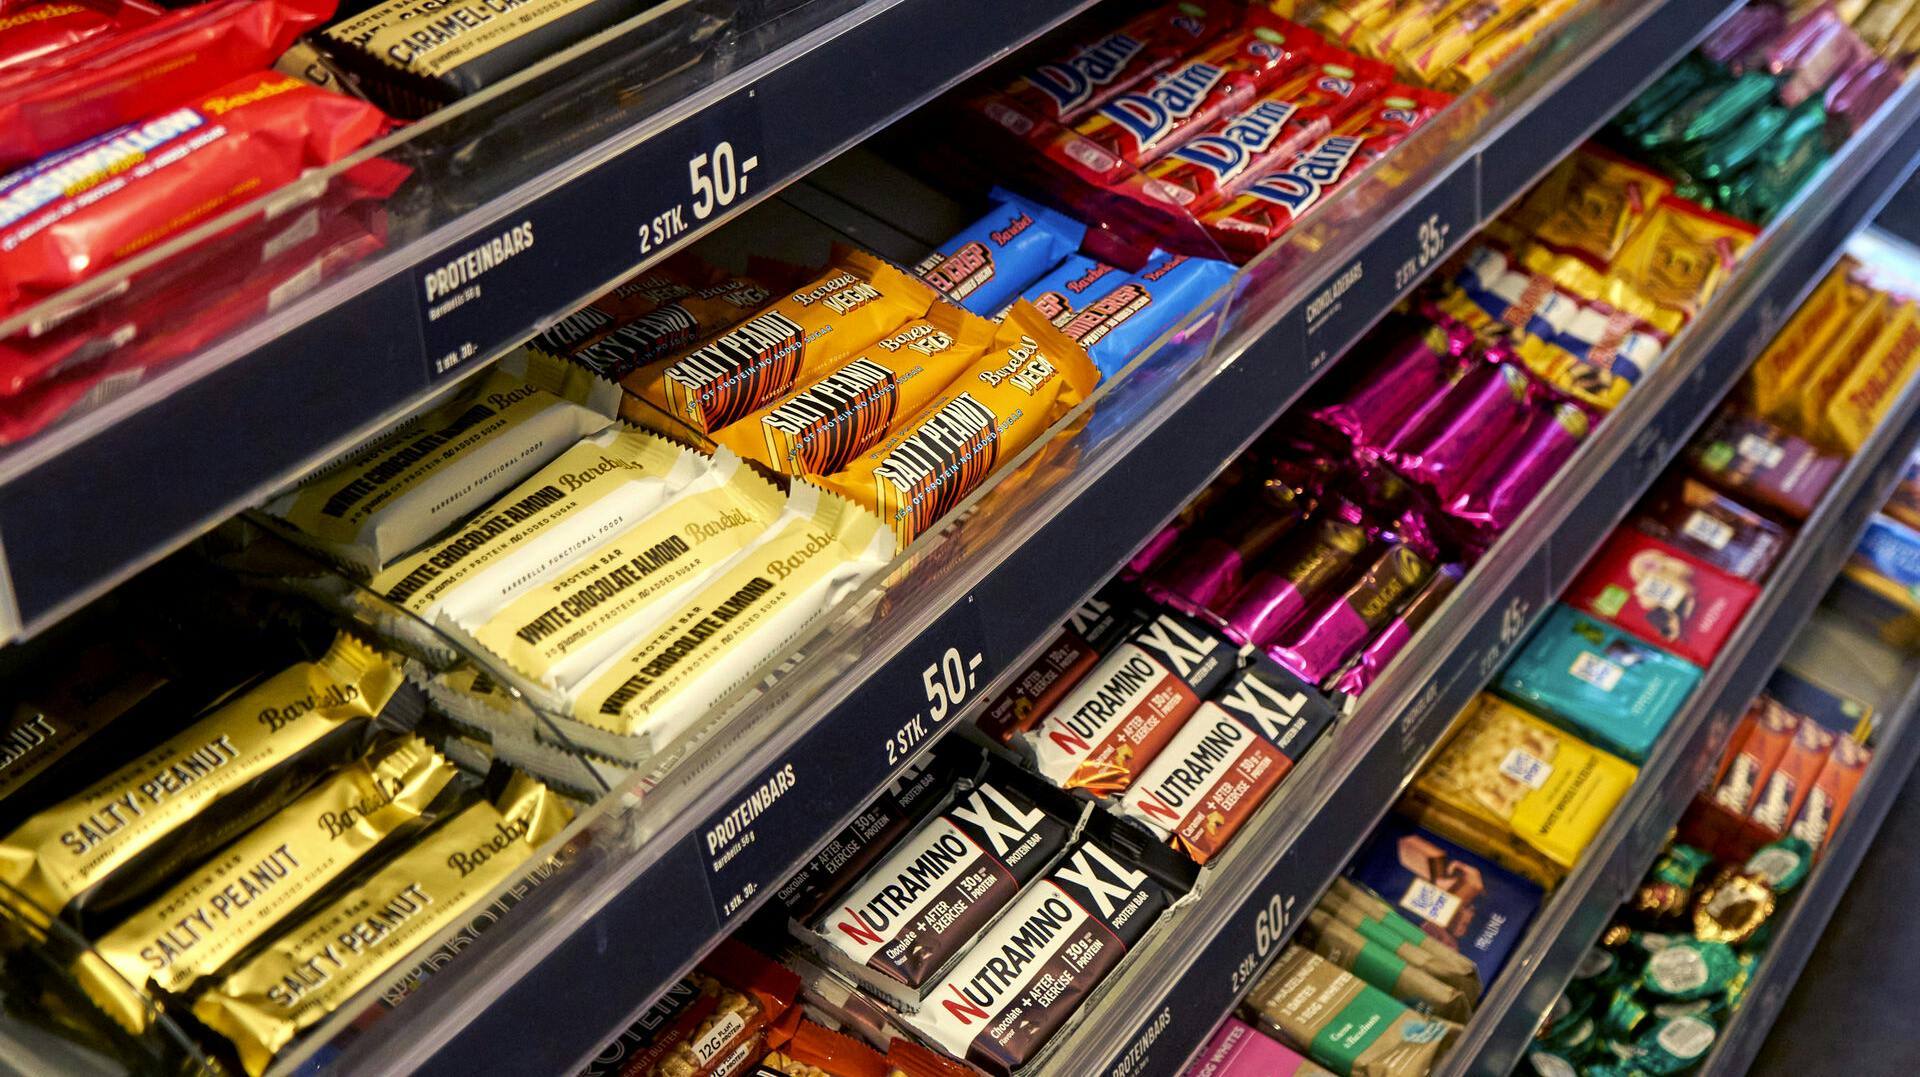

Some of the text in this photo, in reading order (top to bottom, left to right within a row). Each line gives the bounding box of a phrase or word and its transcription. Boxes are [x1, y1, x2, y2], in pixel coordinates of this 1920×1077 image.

[340, 7, 393, 34] PROTEIN
[389, 5, 491, 65] CARAMEL
[1247, 40, 1284, 62] 2
[1028, 34, 1146, 115] Daim
[1100, 60, 1228, 153] Daim
[1319, 75, 1356, 98] 2
[1170, 98, 1298, 187] Daim
[1382, 107, 1419, 127] 2
[638, 141, 758, 255] 2 STK. 50,-
[1241, 135, 1366, 218] Daim
[424, 221, 535, 302] PROTEINBARS
[664, 343, 740, 391] SALTY
[716, 310, 805, 360] PEANUT
[717, 367, 756, 393] PROTEIN
[772, 340, 802, 362] ADDED
[804, 324, 833, 345] SUGAR
[761, 391, 836, 435] SALTY
[810, 356, 896, 404] PEANUT
[816, 410, 850, 435] PROTEIN
[867, 382, 895, 403] ADDED
[896, 366, 924, 385] SUGAR
[364, 431, 449, 484] CHOCOLATE
[403, 457, 442, 484] PROTEIN
[481, 418, 508, 437] SUGAR
[873, 434, 944, 493] SALTY
[917, 391, 996, 454] PEANUT
[925, 463, 959, 494] PROTEIN
[973, 431, 997, 458] ADDED
[997, 408, 1024, 433] SUGAR
[385, 485, 567, 605] WHITE CHOCOLATE ALMOND
[426, 501, 579, 601] grams PROTEIN ADDED SUGAR
[553, 548, 624, 593] PROTEIN BAR
[516, 534, 690, 646] WHITE CHOCOLATE ALMOND
[599, 598, 637, 624] PROTEIN
[651, 573, 676, 593] ADDED
[675, 557, 702, 576] SUGAR
[600, 576, 776, 716] WHITE CHOCOLATE ALMOND
[632, 605, 703, 663] PROTEIN BAR
[682, 646, 720, 680] PROTEIN
[733, 611, 761, 638] ADDED
[760, 591, 787, 616] SUGAR
[1137, 613, 1219, 678] XL
[885, 647, 983, 766] 2 STK. 50,-
[1049, 655, 1155, 756] NUTRAMINO
[1222, 672, 1308, 741] XL
[61, 791, 145, 857] SALTY
[140, 734, 241, 804] PEANUT
[899, 773, 937, 808] PROTEIN BAR
[1137, 720, 1242, 822] NUTRAMINO
[706, 763, 796, 856] PROTEINBARS
[864, 814, 890, 841] PROTEIN
[952, 783, 1045, 857] XL
[818, 840, 844, 867] AFTER
[825, 839, 861, 875] EXERCISE
[1005, 833, 1043, 868] PROTEIN BAR
[1054, 841, 1148, 920] XL
[140, 907, 213, 970] SALTY
[210, 843, 302, 920] PEANUT
[777, 870, 810, 901] Chocolate
[838, 832, 967, 946] NUTRAMINO
[924, 901, 950, 926] AFTER
[932, 899, 968, 935] EXERCISE
[970, 874, 998, 900] PROTEIN
[1112, 891, 1150, 930] PROTEIN BAR
[267, 943, 344, 1009] SALTY
[338, 881, 434, 957] PEANUT
[886, 930, 917, 960] Chocolate
[943, 896, 1073, 1025] NUTRAMINO
[1077, 938, 1104, 970] PROTEIN
[1231, 972, 1240, 994] 2
[1256, 893, 1295, 957] 60,-
[1030, 973, 1056, 1001] AFTER
[1039, 970, 1075, 1009] EXERCISE
[698, 1036, 721, 1061] 12G
[991, 1006, 1023, 1039] Chocolate
[1111, 1006, 1171, 1077] PROTEINBARS
